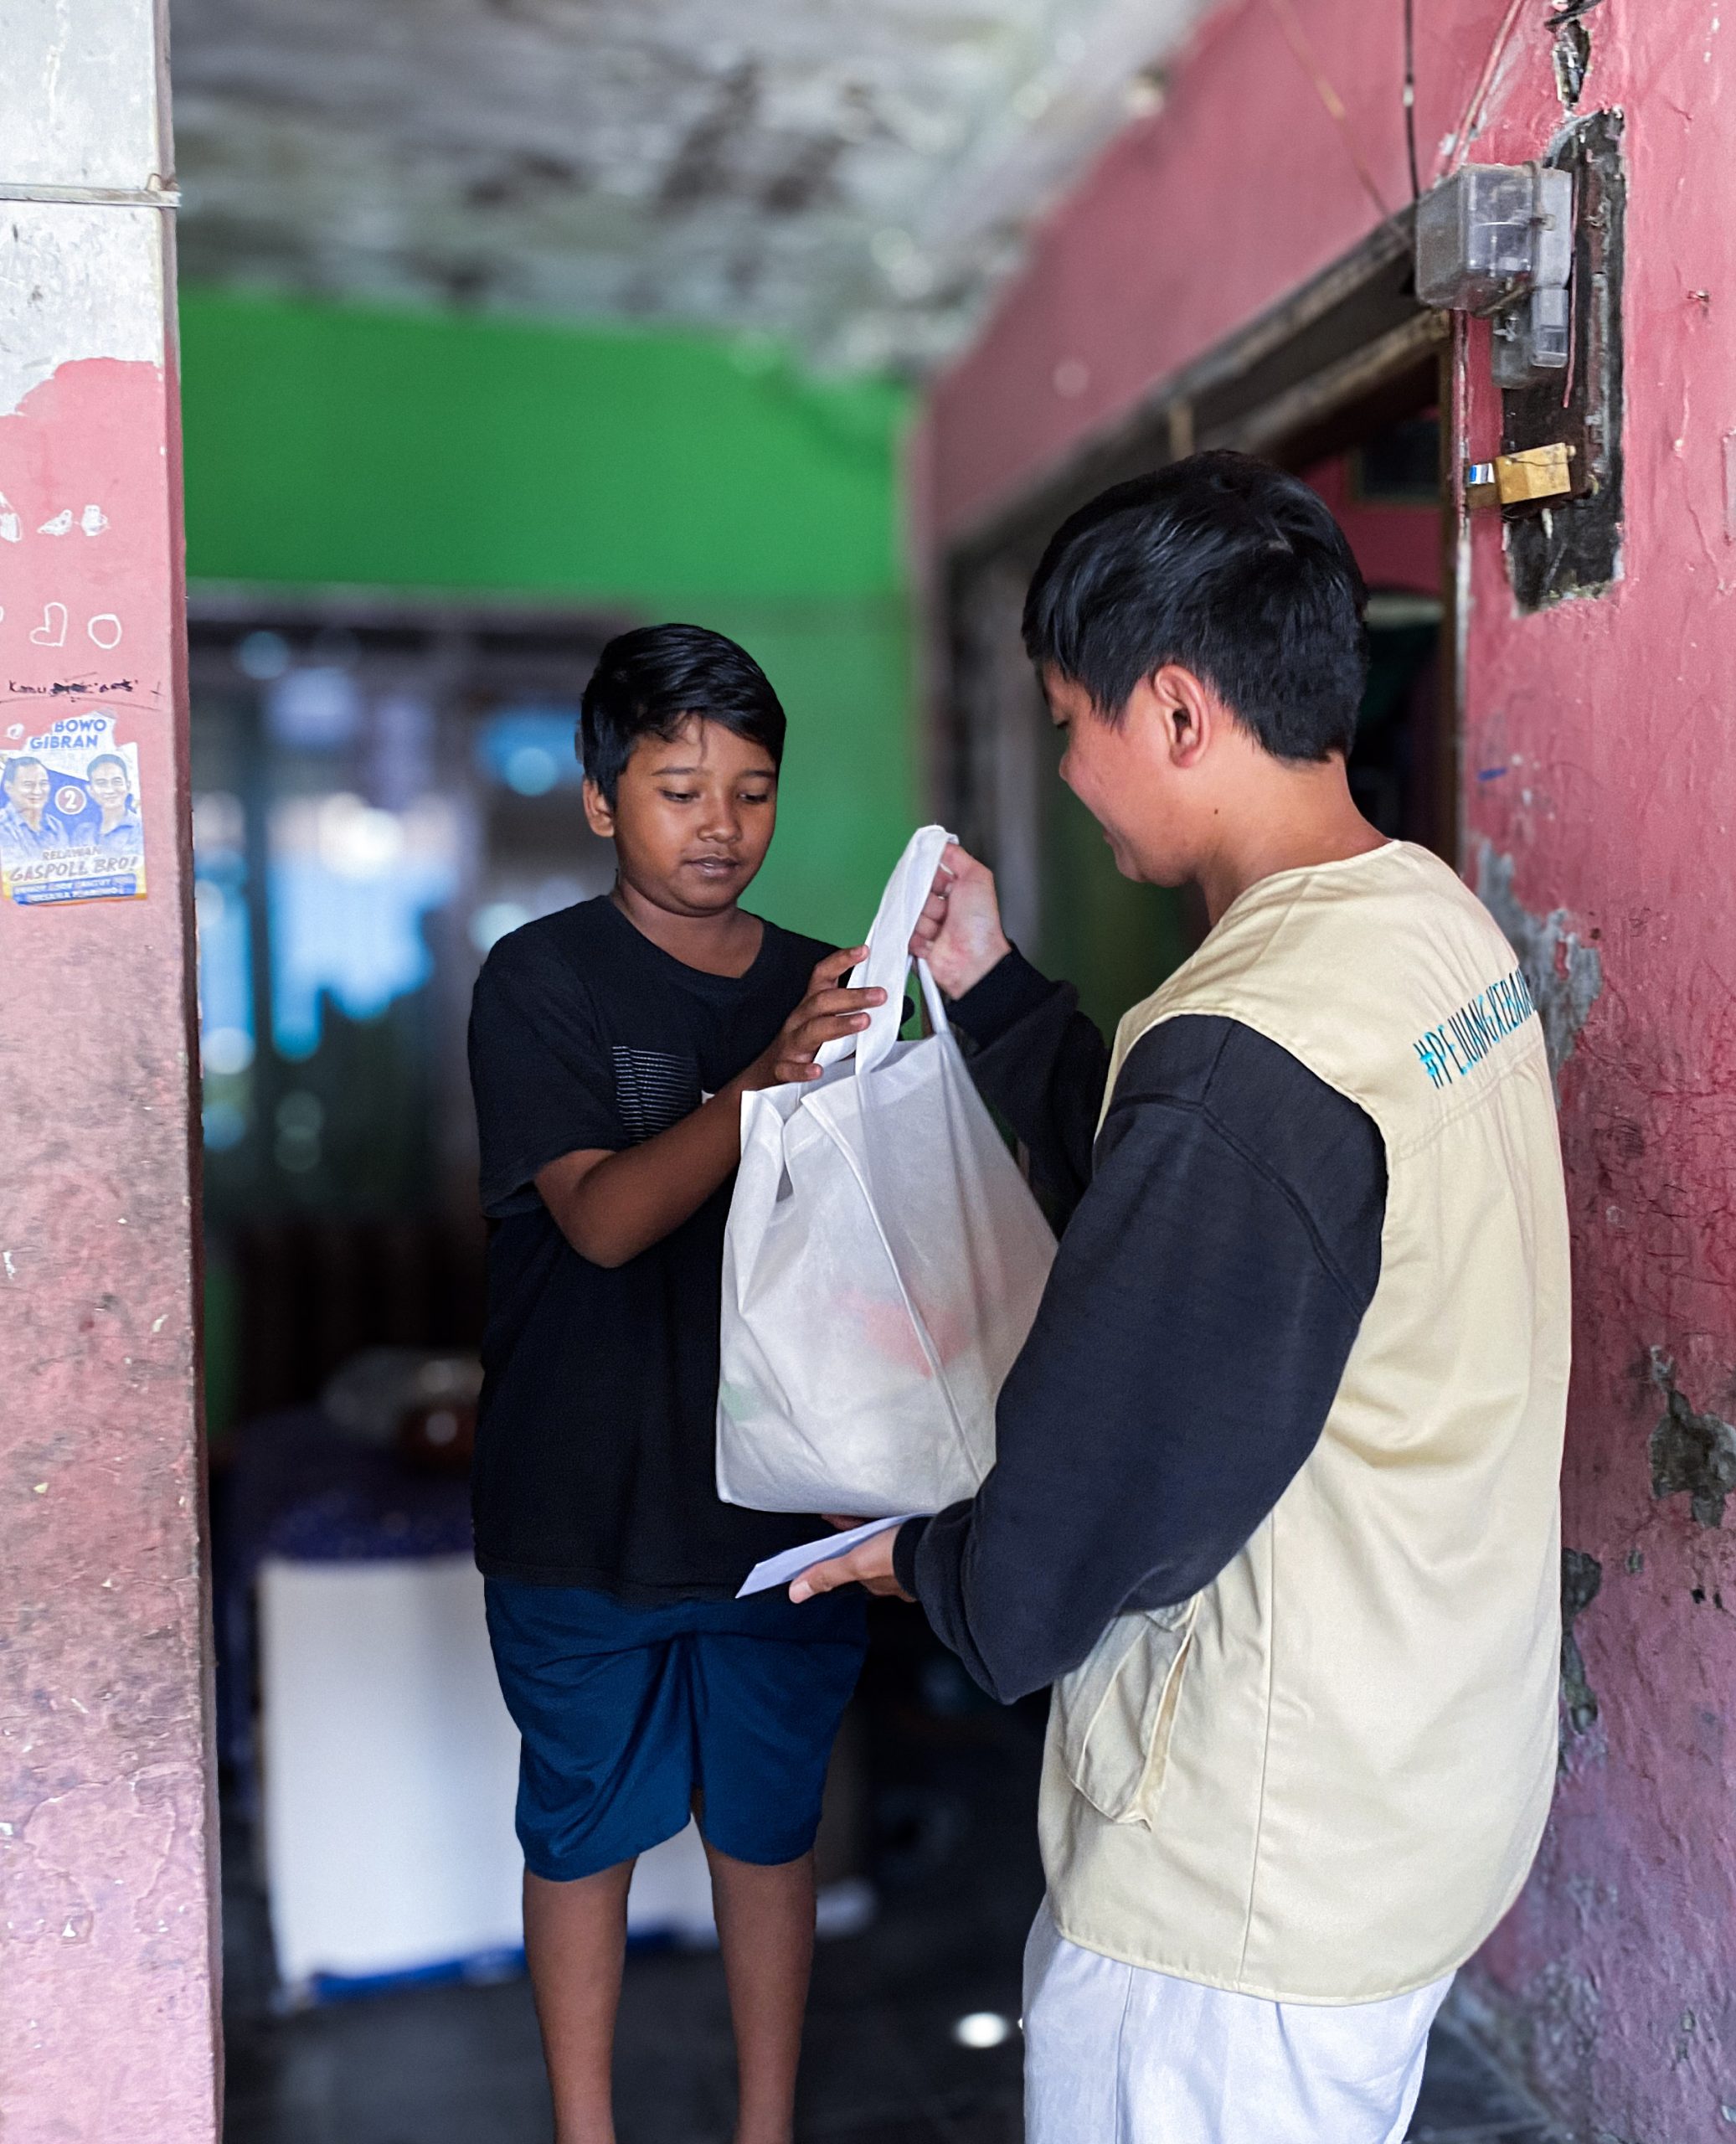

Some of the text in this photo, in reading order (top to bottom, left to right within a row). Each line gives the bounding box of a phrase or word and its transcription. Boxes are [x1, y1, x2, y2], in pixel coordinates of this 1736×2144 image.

[30, 734, 99, 750] GIBRAN
[64, 790, 77, 809] 2
[9, 856, 138, 882] GASPOLL BRO!
